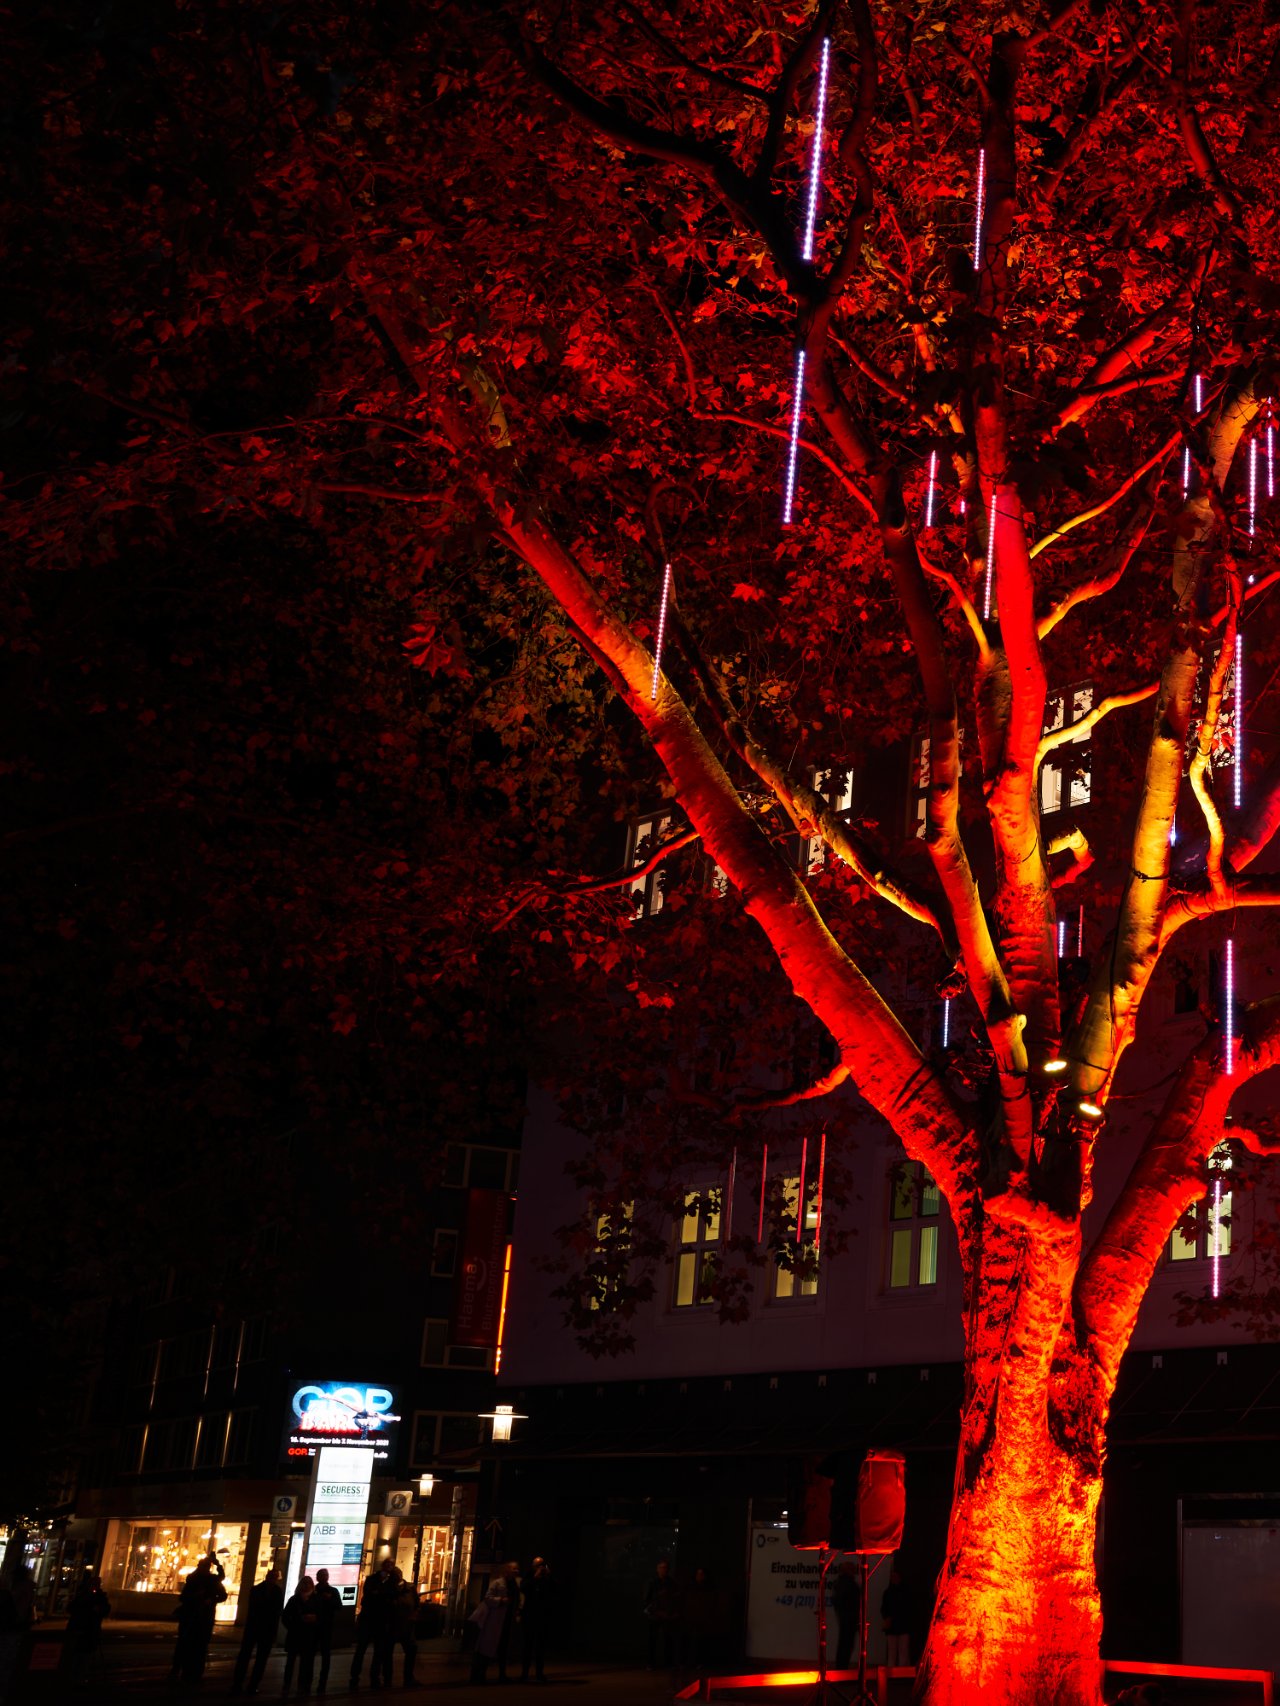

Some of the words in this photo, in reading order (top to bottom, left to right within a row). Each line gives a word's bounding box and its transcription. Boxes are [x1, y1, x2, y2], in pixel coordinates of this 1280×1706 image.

[457, 1263, 478, 1329] Haema
[292, 1385, 393, 1419] GOP
[299, 1437, 332, 1445] September
[332, 1437, 341, 1445] bis
[346, 1438, 376, 1446] November
[320, 1485, 361, 1494] SECURESS
[785, 1580, 797, 1589] zu
